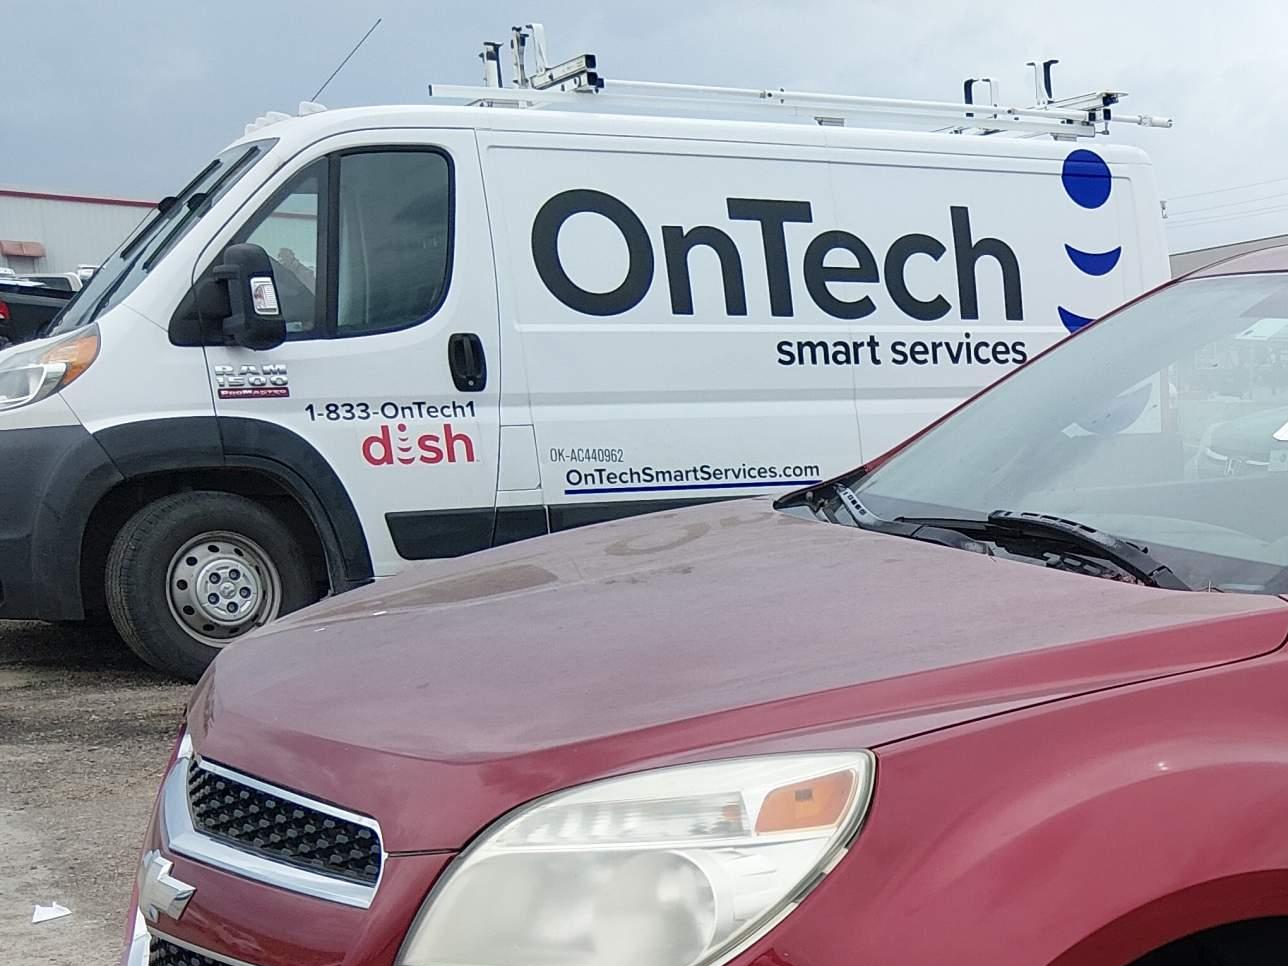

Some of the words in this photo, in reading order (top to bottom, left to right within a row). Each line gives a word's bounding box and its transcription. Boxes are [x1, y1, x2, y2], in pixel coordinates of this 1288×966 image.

[531, 188, 1024, 321] OnTech
[777, 335, 882, 365] smart
[890, 332, 1028, 365] services
[214, 364, 288, 375] RAM
[216, 376, 289, 387] 1500
[304, 400, 476, 421] 1-833-OnTech1
[362, 423, 475, 466] dish
[549, 447, 624, 463] OK-AC440962
[565, 463, 820, 486] OnTechSmartServices.com
